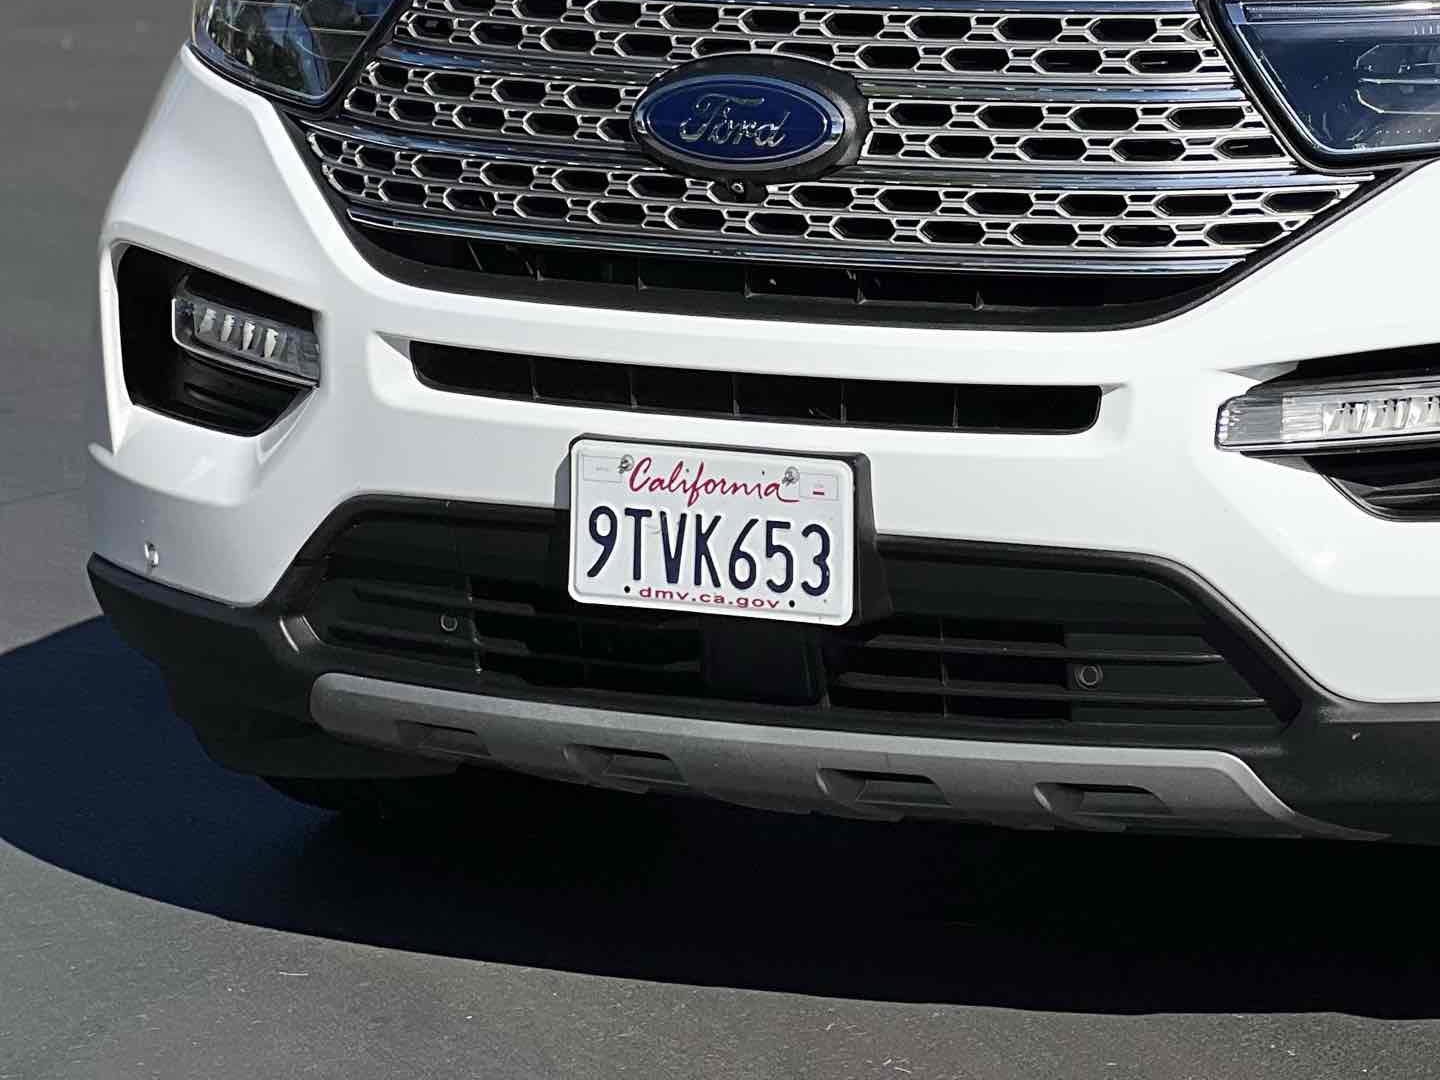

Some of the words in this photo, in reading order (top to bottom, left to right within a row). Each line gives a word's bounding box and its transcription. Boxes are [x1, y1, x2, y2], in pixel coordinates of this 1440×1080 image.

[679, 93, 792, 148] Ford
[628, 457, 800, 506] California
[586, 505, 831, 597] 9TVK653
[639, 586, 780, 609] dmv.ca.gov
